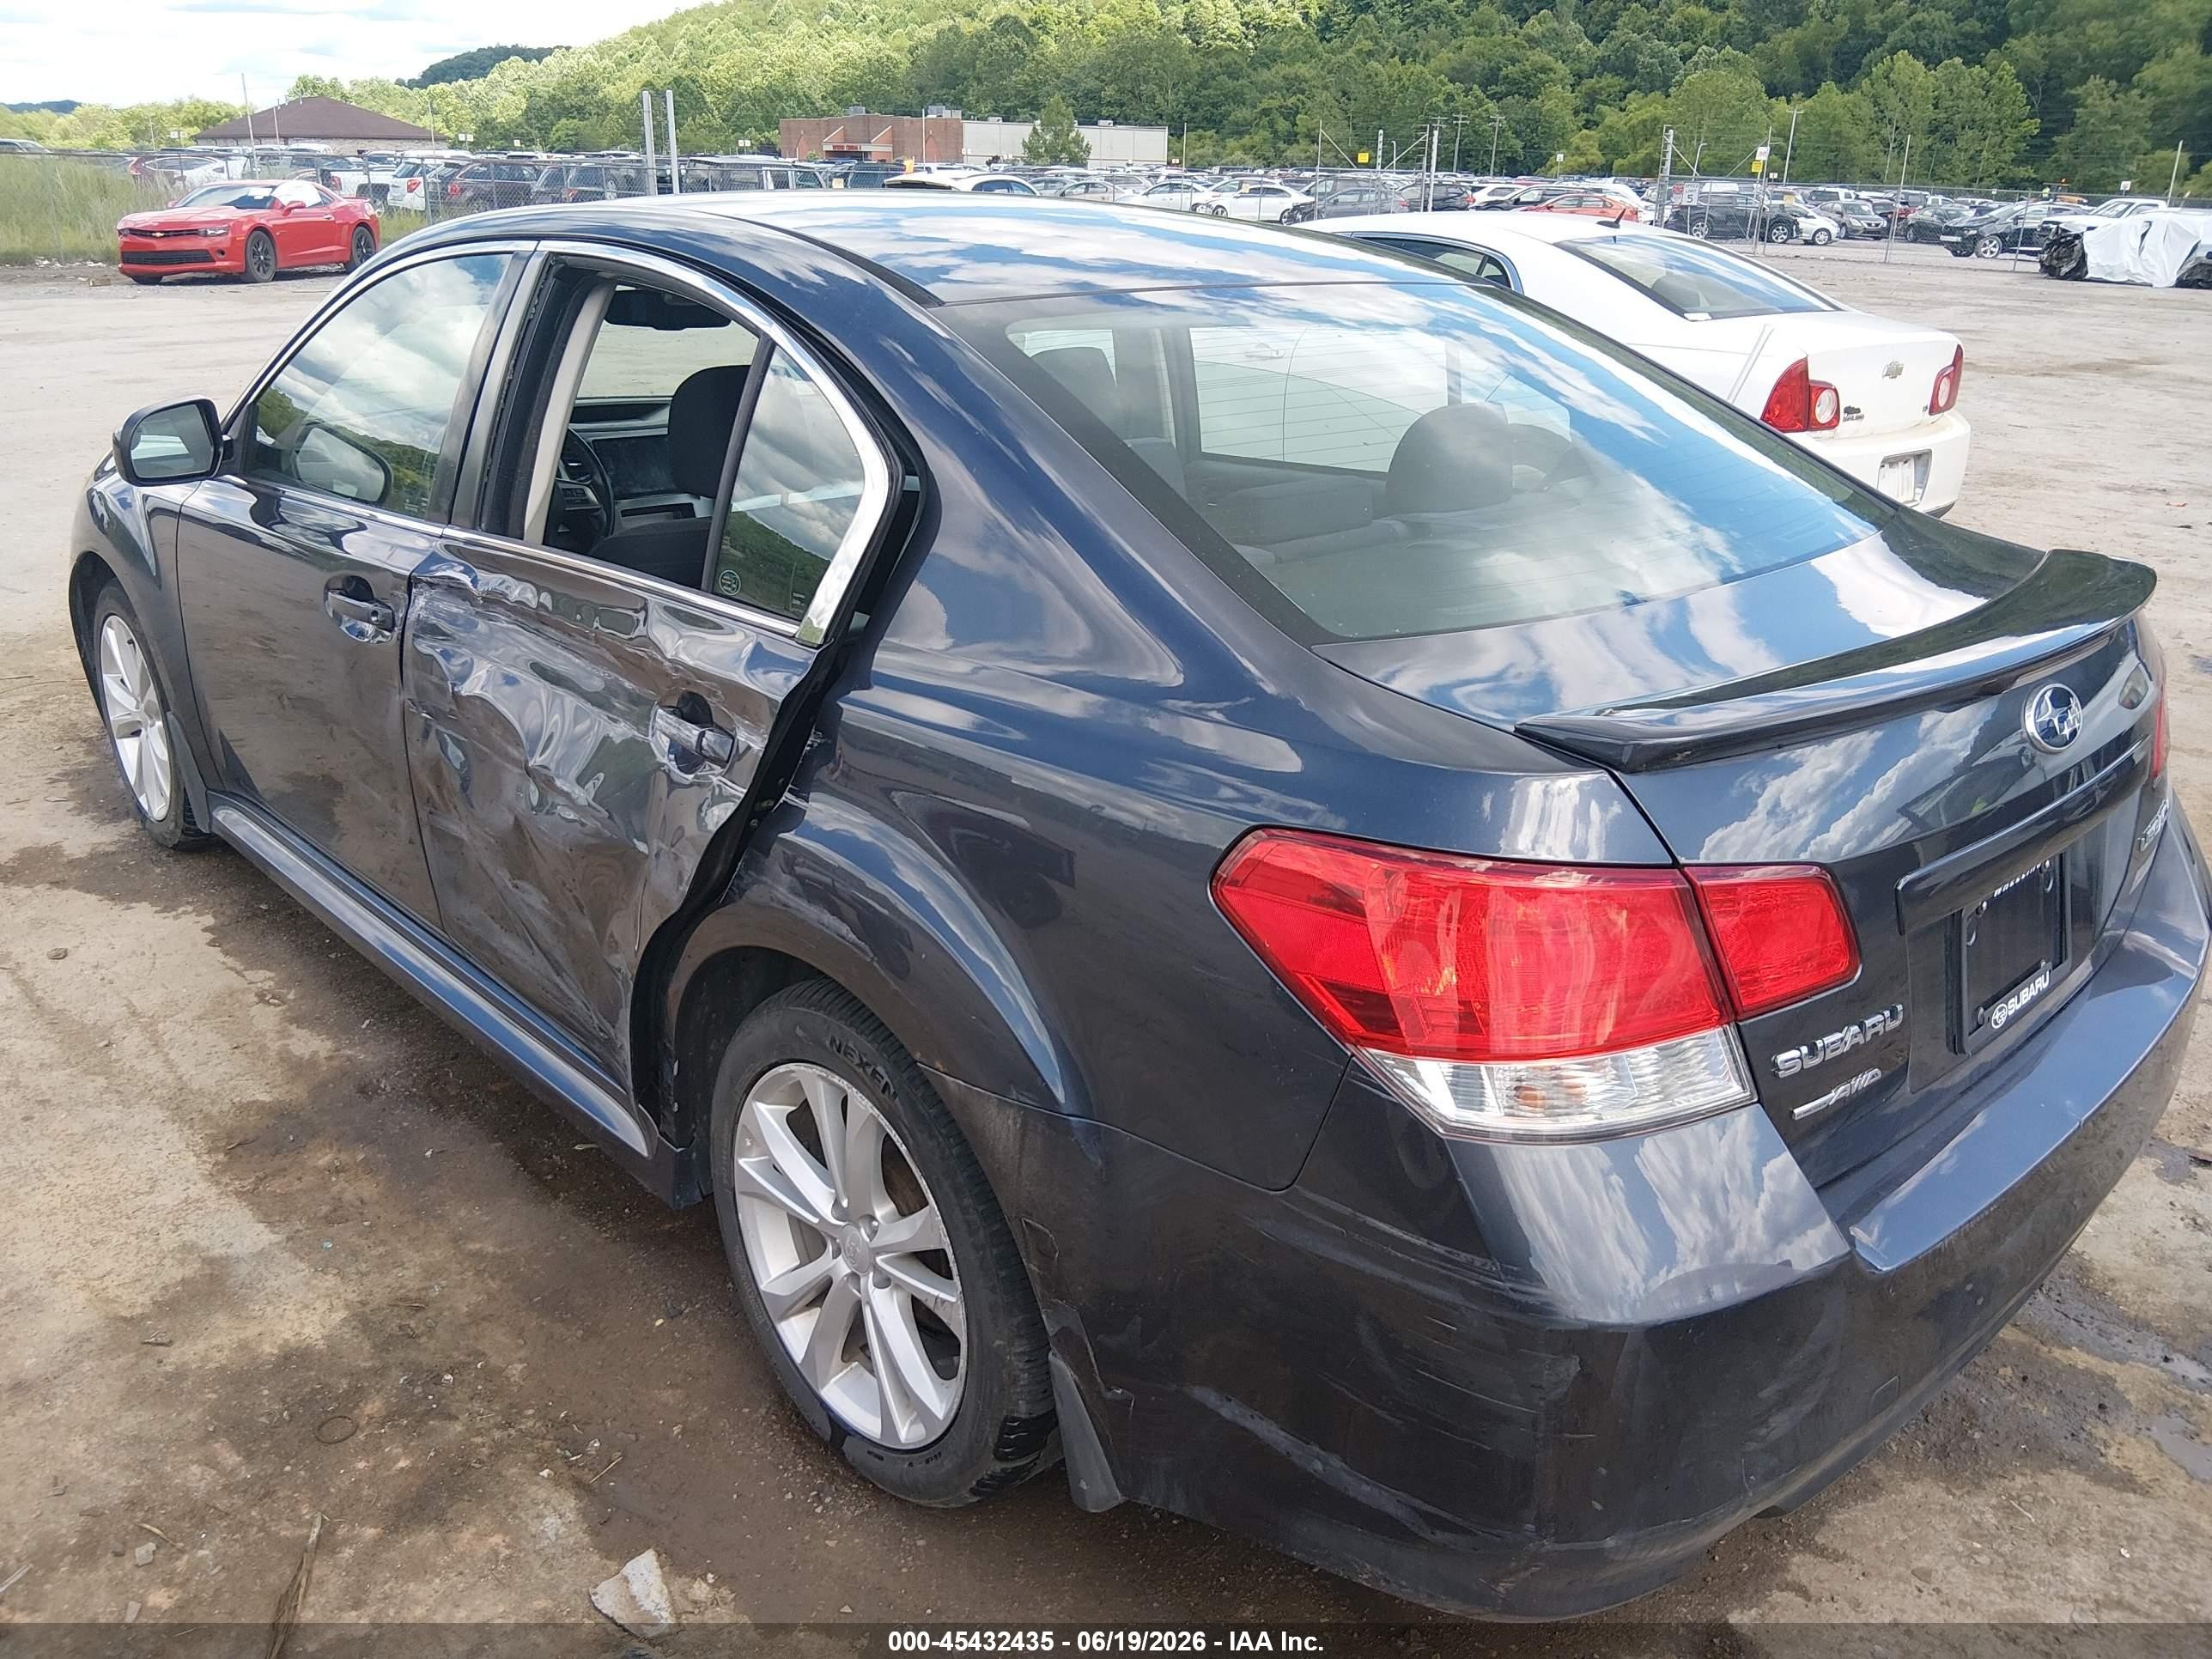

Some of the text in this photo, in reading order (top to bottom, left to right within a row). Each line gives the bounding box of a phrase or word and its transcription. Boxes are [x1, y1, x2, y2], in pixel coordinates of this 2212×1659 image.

[1686, 194, 1693, 203] 5
[2008, 970, 2050, 1016] SUBARU
[828, 1035, 898, 1100] NEXEN
[1771, 1003, 1904, 1079] SUBARU
